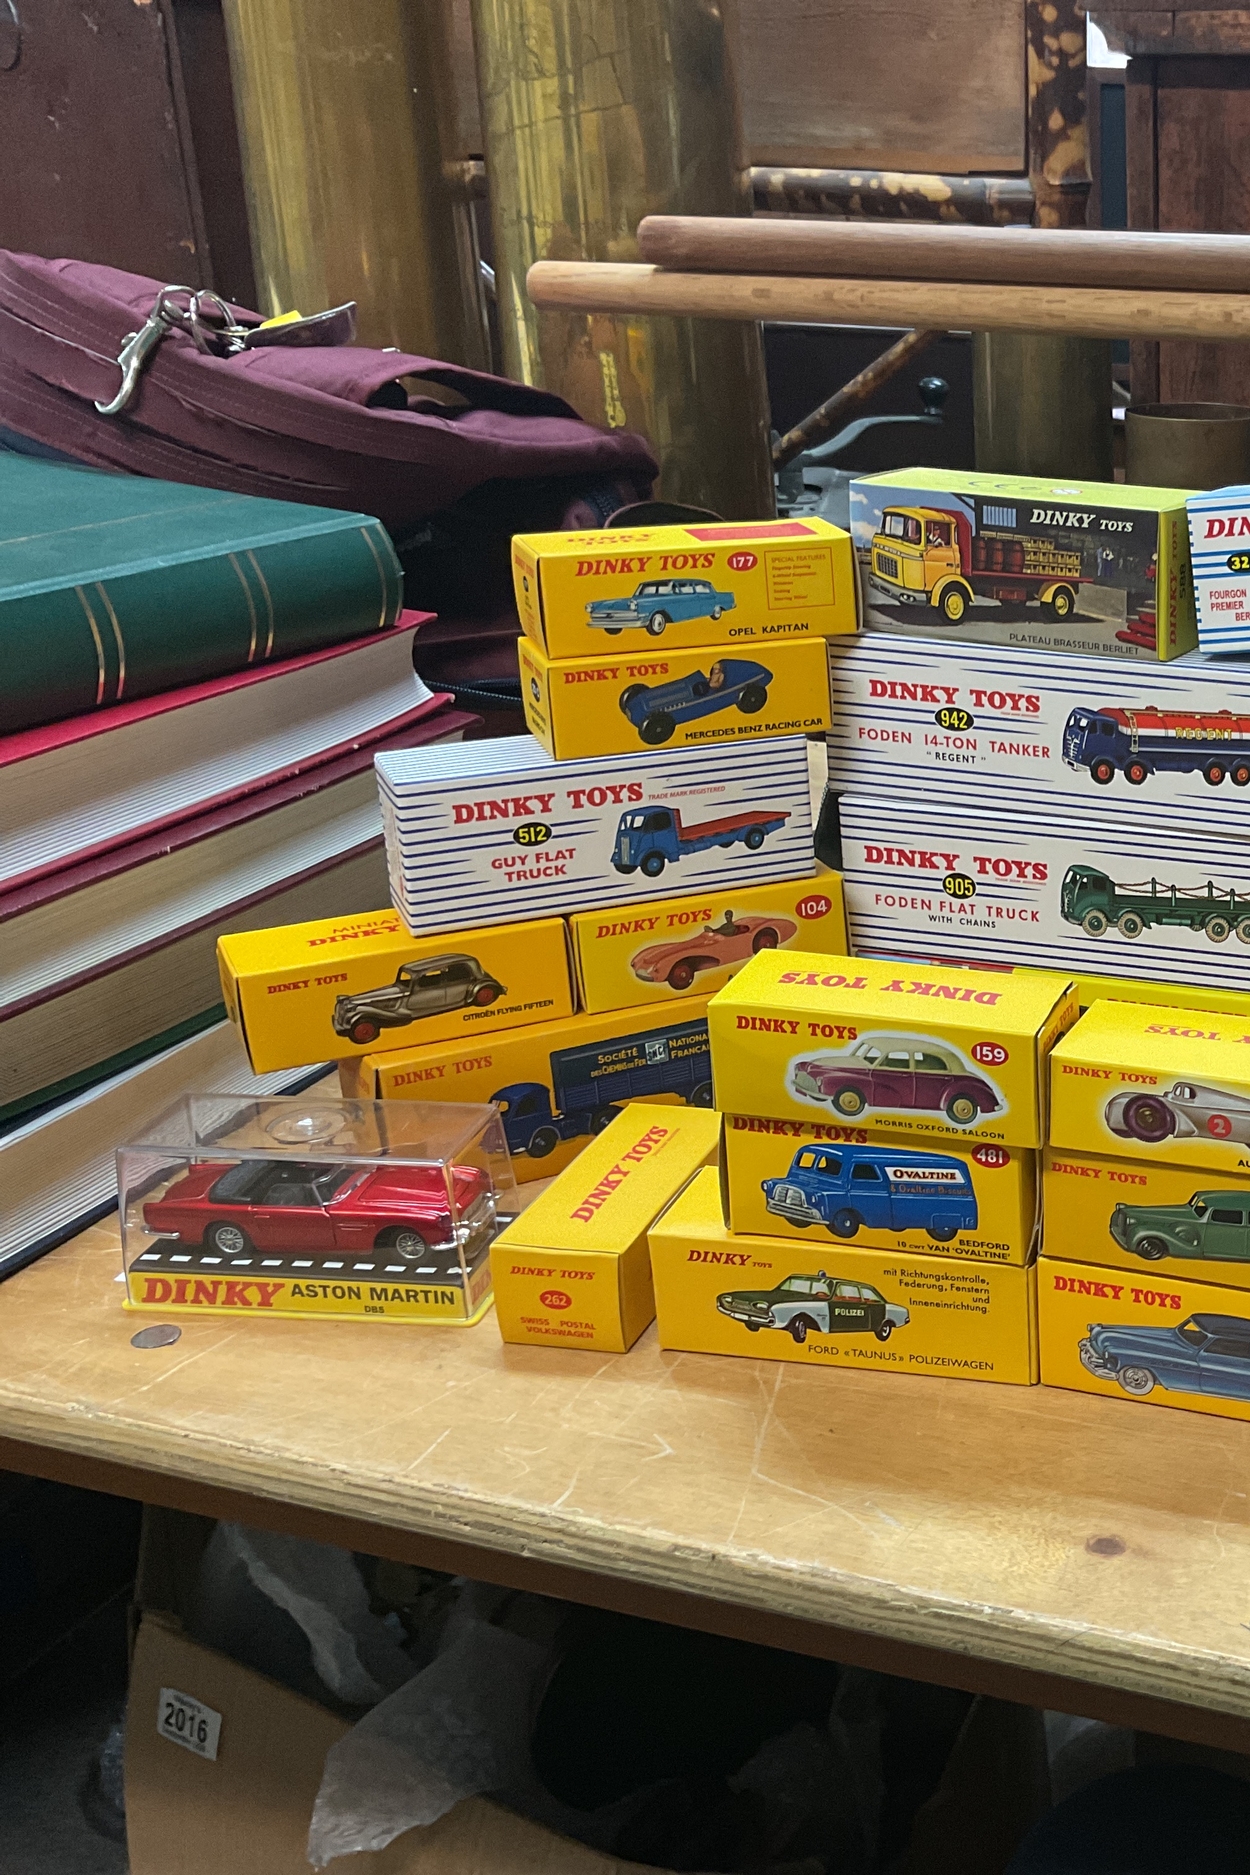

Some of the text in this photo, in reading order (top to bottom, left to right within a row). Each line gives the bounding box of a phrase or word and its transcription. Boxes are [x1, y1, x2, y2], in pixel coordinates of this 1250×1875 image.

[1030, 508, 1133, 533] DINKY TOYS
[575, 553, 715, 576] DINKY TOYS
[732, 555, 754, 568] 177
[1209, 589, 1247, 600] FOURGON
[1211, 601, 1244, 612] PREMIER
[729, 623, 809, 637] OPEL KAPITAN
[1009, 633, 1139, 655] PLATEAU BRASSEUR BERLIET
[940, 712, 968, 727] 942
[685, 718, 823, 740] MERCEDES BENZ RACING CAR
[1175, 726, 1233, 740] REGENT
[858, 727, 1051, 758] FODEN 14-TON TANKER
[689, 786, 726, 796] REGISTERED
[518, 826, 548, 842] 512
[491, 849, 576, 870] GUY FLAT
[864, 846, 1048, 881] DINKY TOYS
[504, 864, 567, 882] TRUCK
[945, 878, 973, 896] 905
[801, 901, 827, 916] 104
[875, 895, 1040, 923] FODEN FLAT TRUCK
[596, 909, 712, 938] DINKY TOYS
[928, 915, 997, 929] WITH CHAINS
[267, 973, 348, 994] DINKY TOYS
[778, 972, 1002, 1006] DINKY TOYS
[463, 999, 554, 1022] CITROËN FLYING FIFTEEN
[976, 1046, 1005, 1062] 159
[875, 1119, 1005, 1139] MORRIS OXFORD SALOON
[1213, 1119, 1226, 1133] 2
[977, 1148, 1003, 1163] 481
[893, 1169, 956, 1180] OVALTINE
[959, 1240, 1010, 1250] BEDFORD
[687, 1249, 773, 1269] DINKY TOYS
[510, 1265, 595, 1280] DINKY TOYS
[900, 1270, 990, 1286] Richtungskontrolle,
[143, 1277, 456, 1308] DINKY ASTON MARTIN
[899, 1280, 990, 1294] Federung, Fenstern
[545, 1293, 567, 1306] 262
[909, 1298, 990, 1314] Inneneinrichtung.
[972, 1295, 990, 1304] und
[835, 1308, 865, 1316] POLIZEI
[520, 1317, 596, 1330] SWISS POSTAL
[526, 1326, 594, 1339] VOLKSWAGEN
[163, 1702, 208, 1744] 2016
